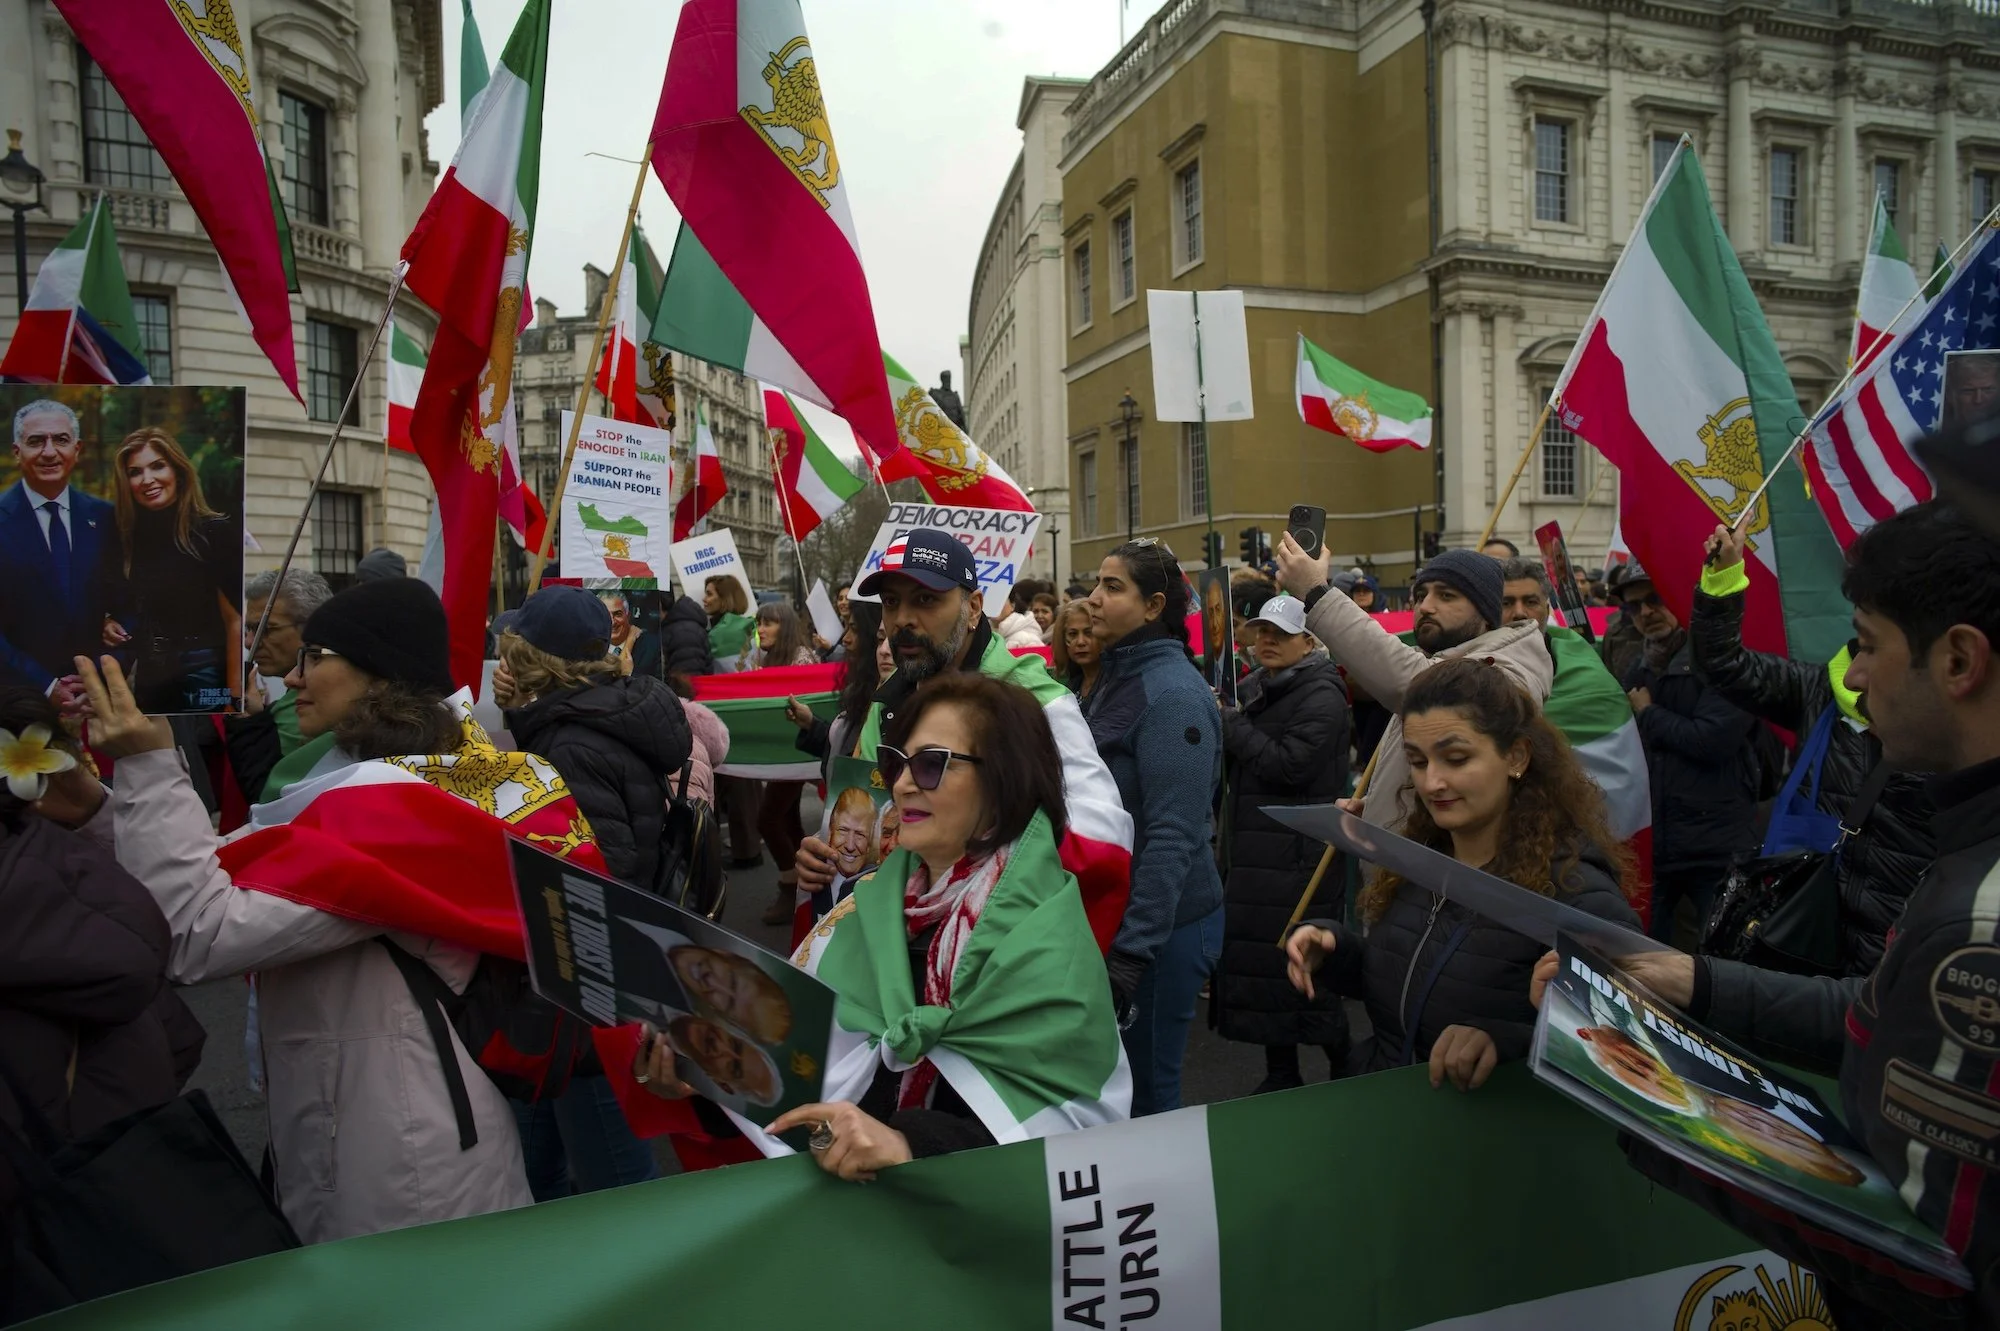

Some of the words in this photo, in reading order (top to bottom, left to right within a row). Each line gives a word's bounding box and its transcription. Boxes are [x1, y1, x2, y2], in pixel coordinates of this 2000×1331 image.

[575, 439, 625, 456] ENOCIDE
[628, 448, 637, 458] in
[640, 451, 666, 464] IRAN
[596, 429, 623, 442] STOP
[626, 435, 642, 445] the
[573, 474, 621, 490] IRANIAN
[624, 482, 662, 496] PEOPLE
[584, 461, 633, 477] SUPPORT
[636, 470, 652, 480] the
[884, 504, 1039, 535] DEMOCRACY
[694, 546, 716, 560] IRGC
[912, 547, 949, 559] ORACLE
[952, 533, 1016, 558] RAN
[684, 553, 735, 576] TERRORISTS
[562, 873, 607, 918] WE
[568, 910, 614, 983] TRUST
[1570, 956, 1635, 1015] YOU
[1946, 967, 2000, 997] BROG
[578, 975, 617, 1027] YOU
[1642, 1009, 1751, 1085] TRUST
[1752, 1073, 1824, 1118] WE
[1116, 1202, 1161, 1331] URN
